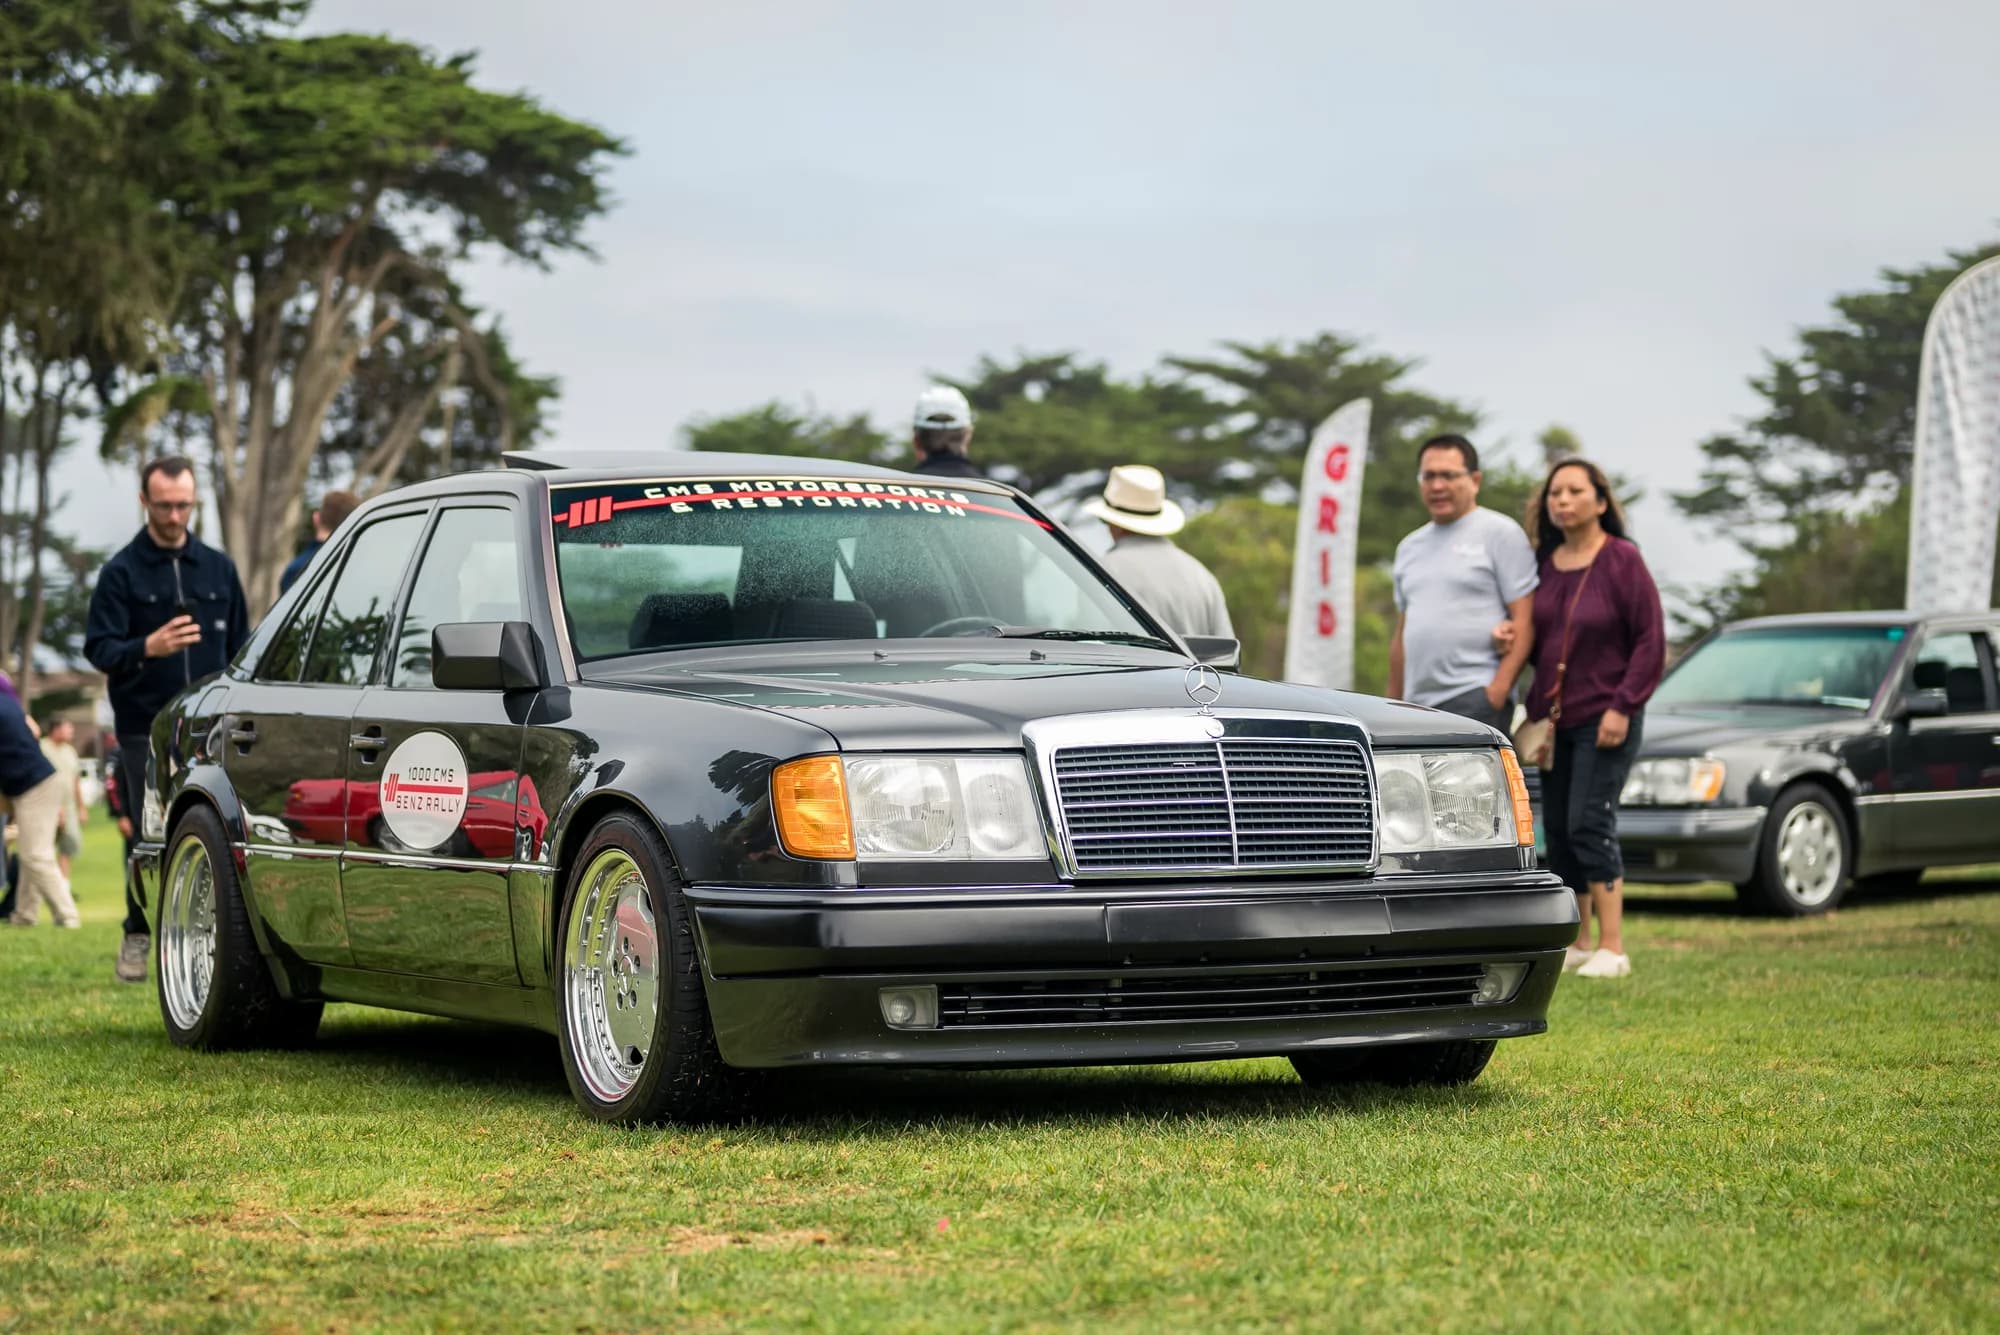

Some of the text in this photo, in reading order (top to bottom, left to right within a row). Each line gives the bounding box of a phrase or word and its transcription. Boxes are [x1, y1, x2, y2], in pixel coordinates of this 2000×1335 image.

[644, 480, 970, 504] CMS MOTORSPORTS
[670, 496, 966, 517] & RESTORATION
[1317, 445, 1350, 636] GRID
